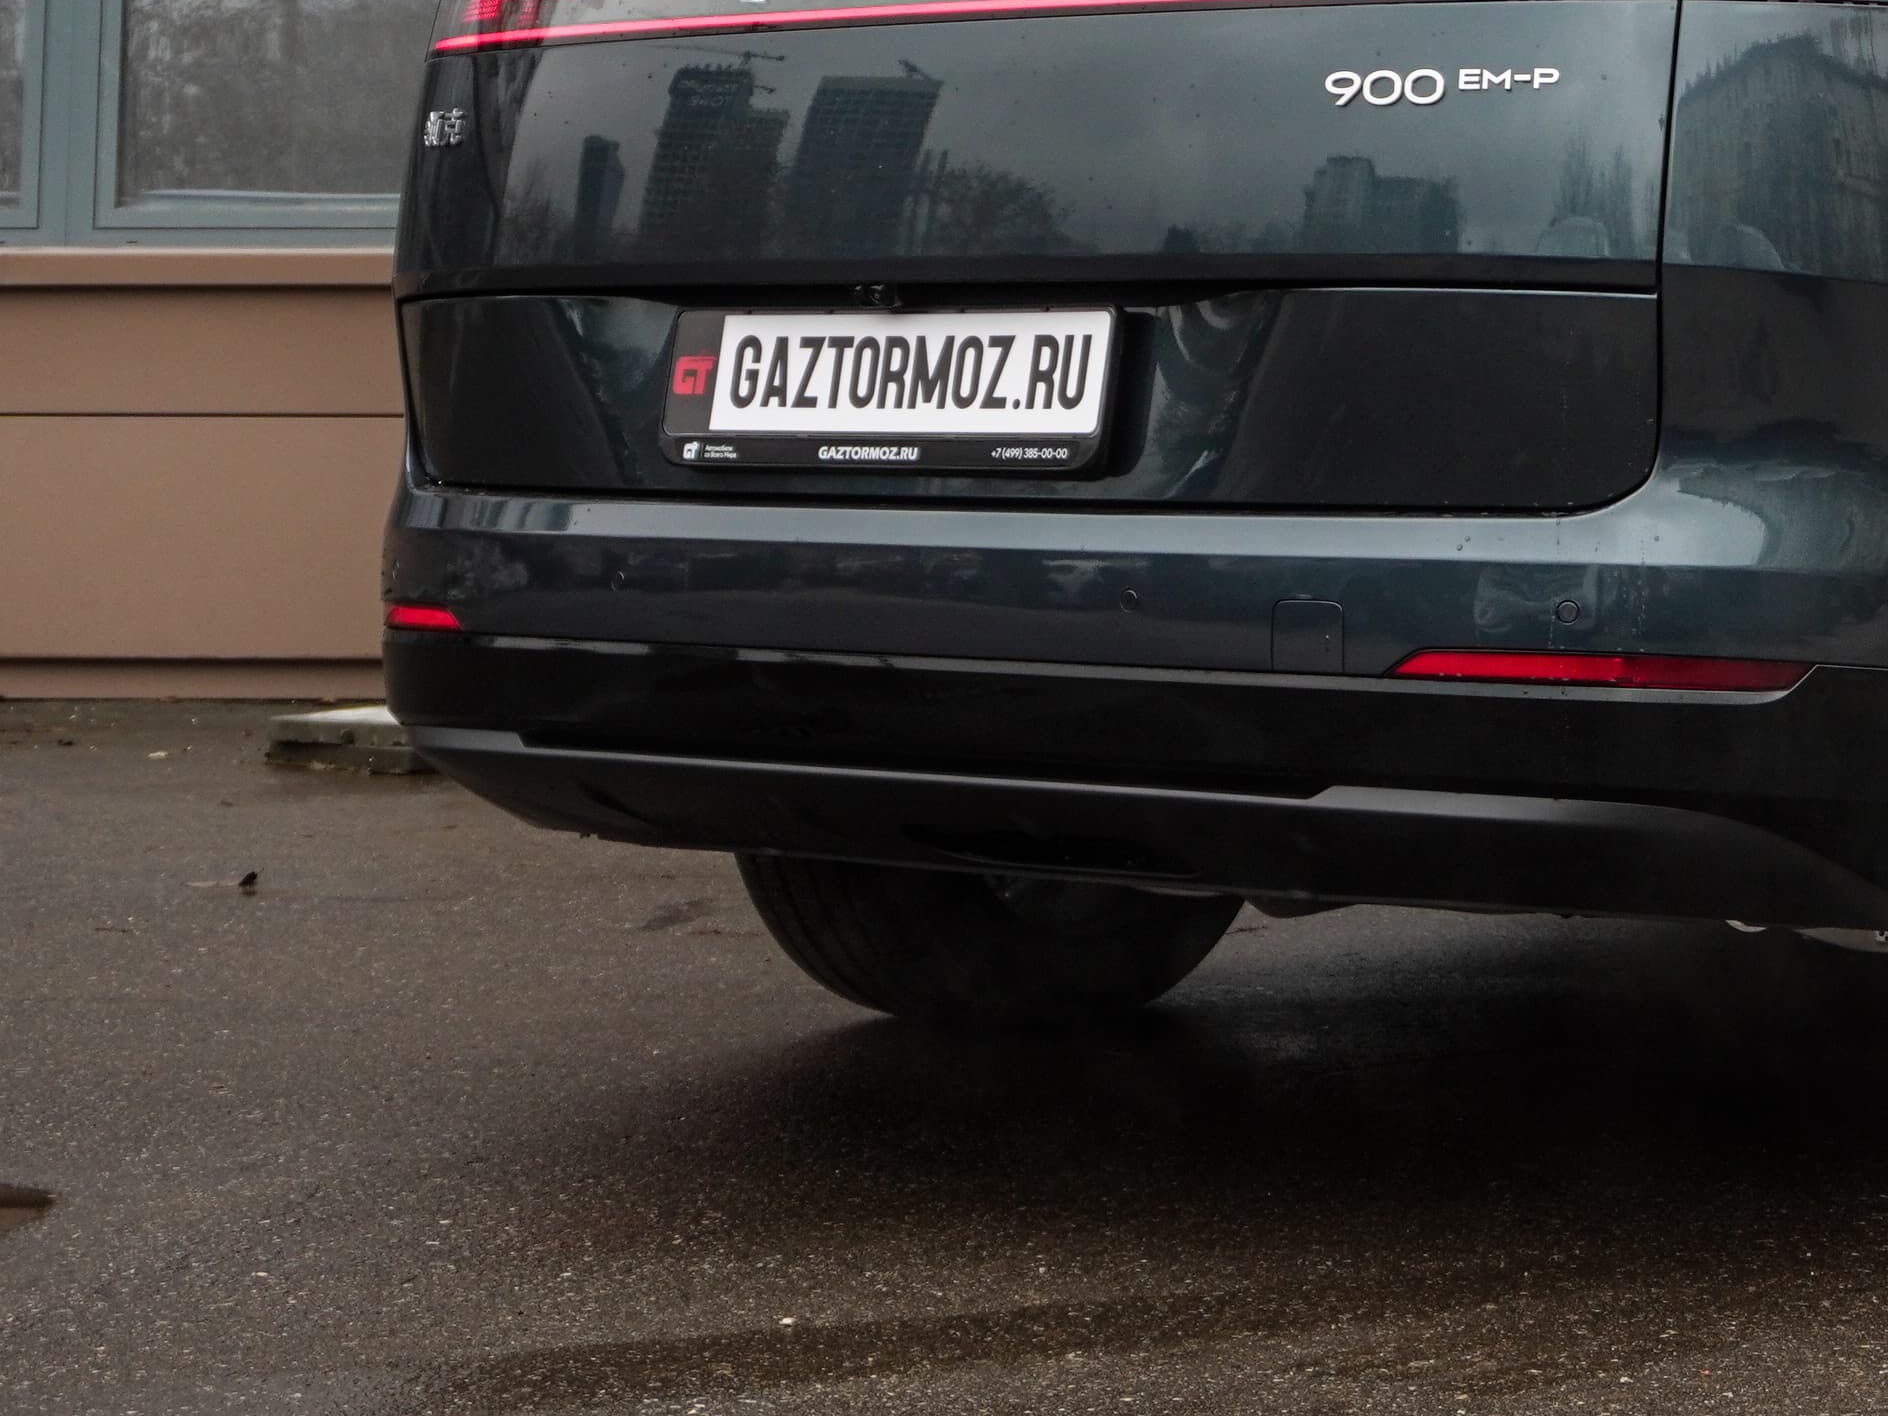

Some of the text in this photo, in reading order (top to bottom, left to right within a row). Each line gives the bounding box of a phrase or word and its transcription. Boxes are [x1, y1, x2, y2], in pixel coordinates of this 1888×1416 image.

[1324, 67, 1560, 106] 900 EM-P
[729, 333, 1093, 410] GAZTORMOZ.RU
[818, 446, 918, 460] GAZTORMOZ.RU
[1002, 448, 1022, 459] (499)
[1023, 448, 1068, 459] 385-00-00
